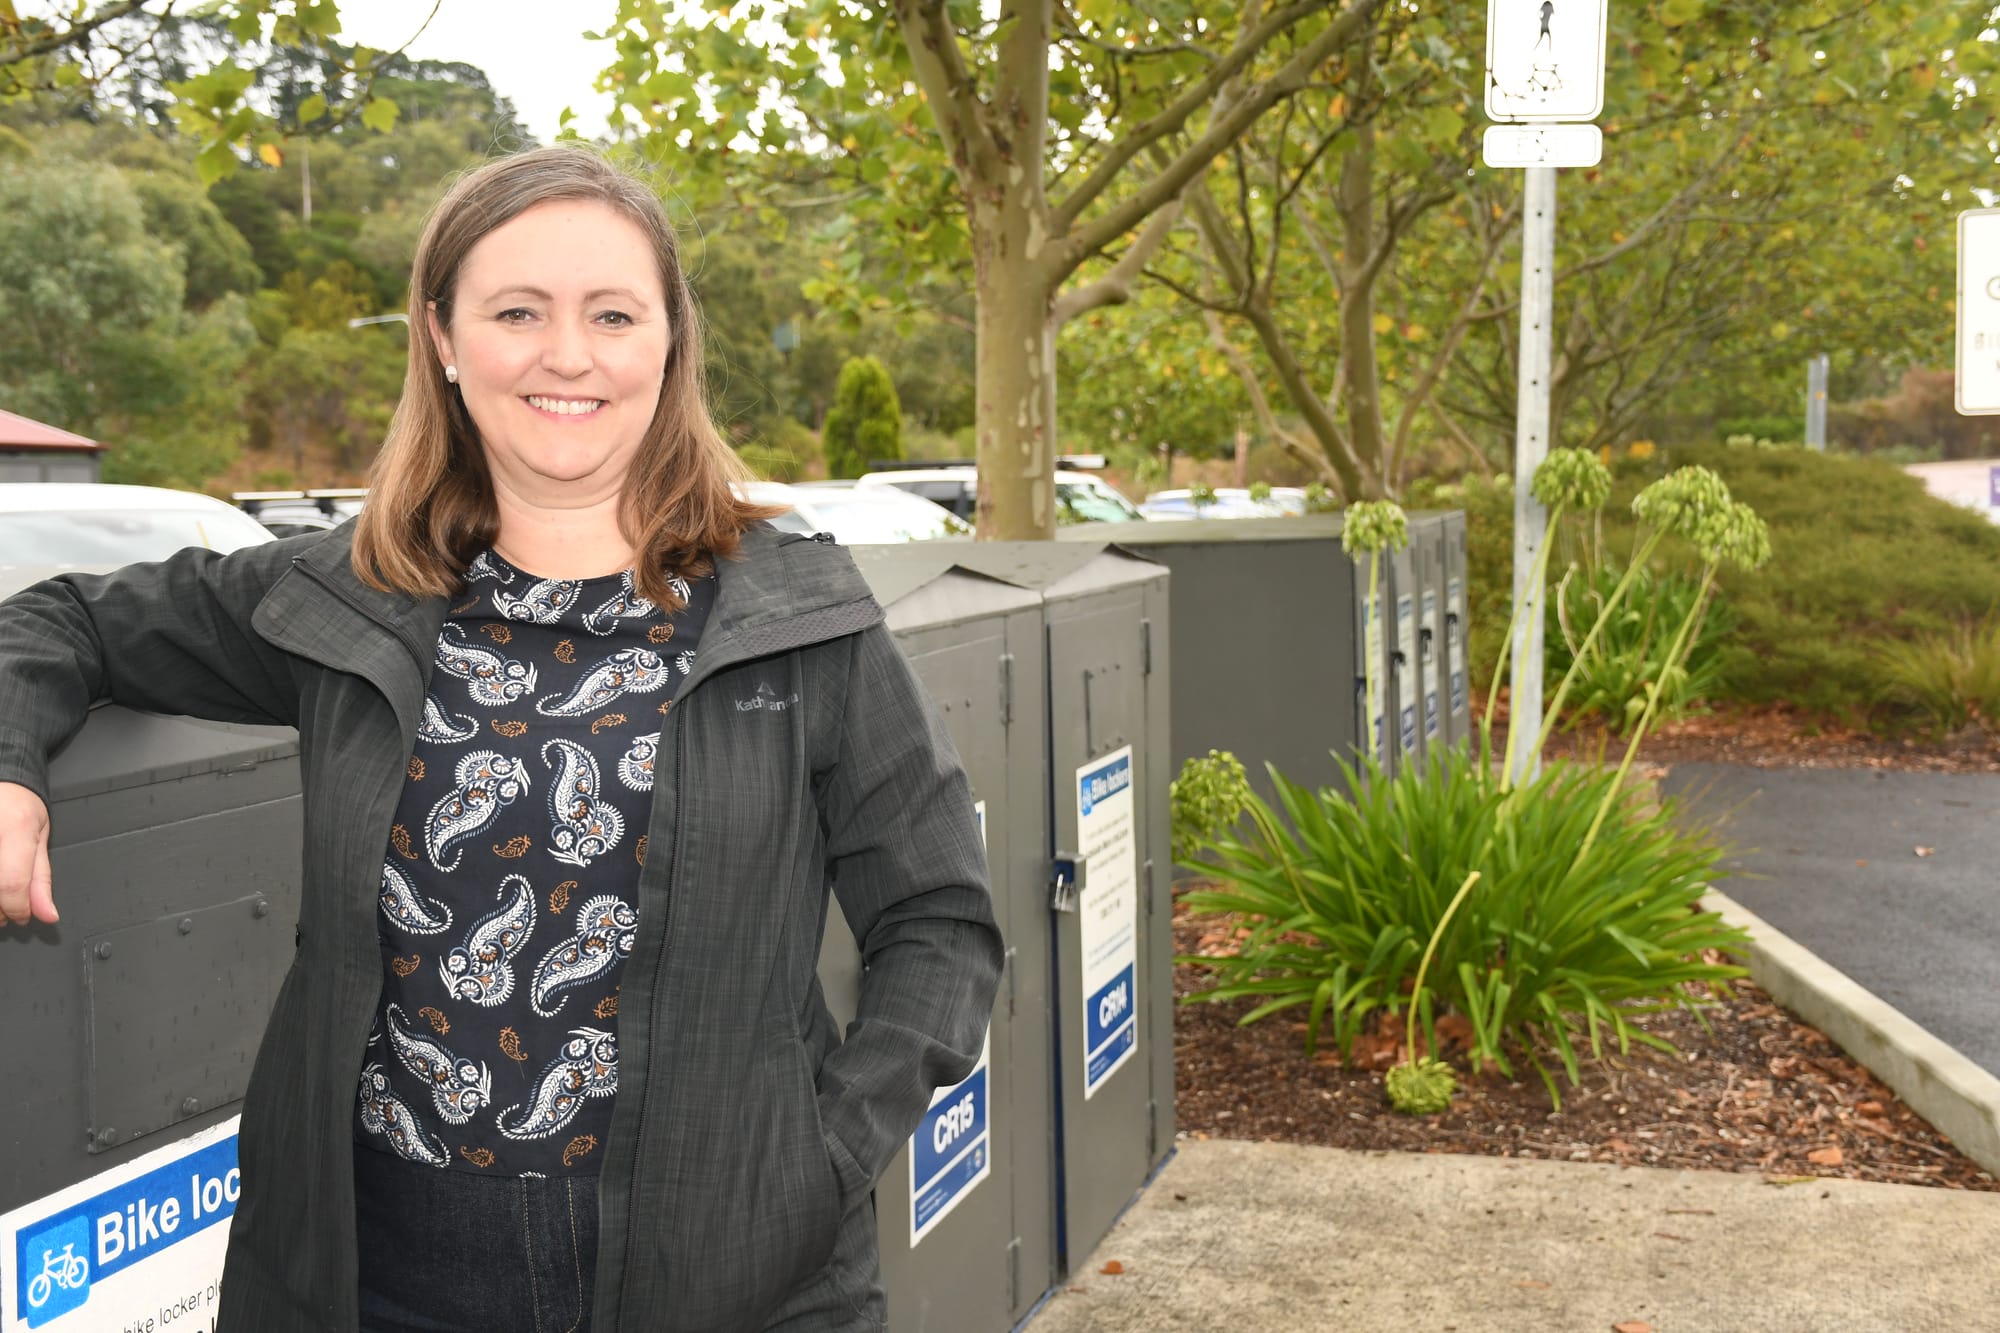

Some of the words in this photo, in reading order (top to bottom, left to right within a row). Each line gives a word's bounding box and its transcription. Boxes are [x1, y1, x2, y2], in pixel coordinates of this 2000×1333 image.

[933, 1091, 974, 1154] CR15
[97, 1196, 180, 1266] Bike
[160, 1291, 202, 1326] locker
